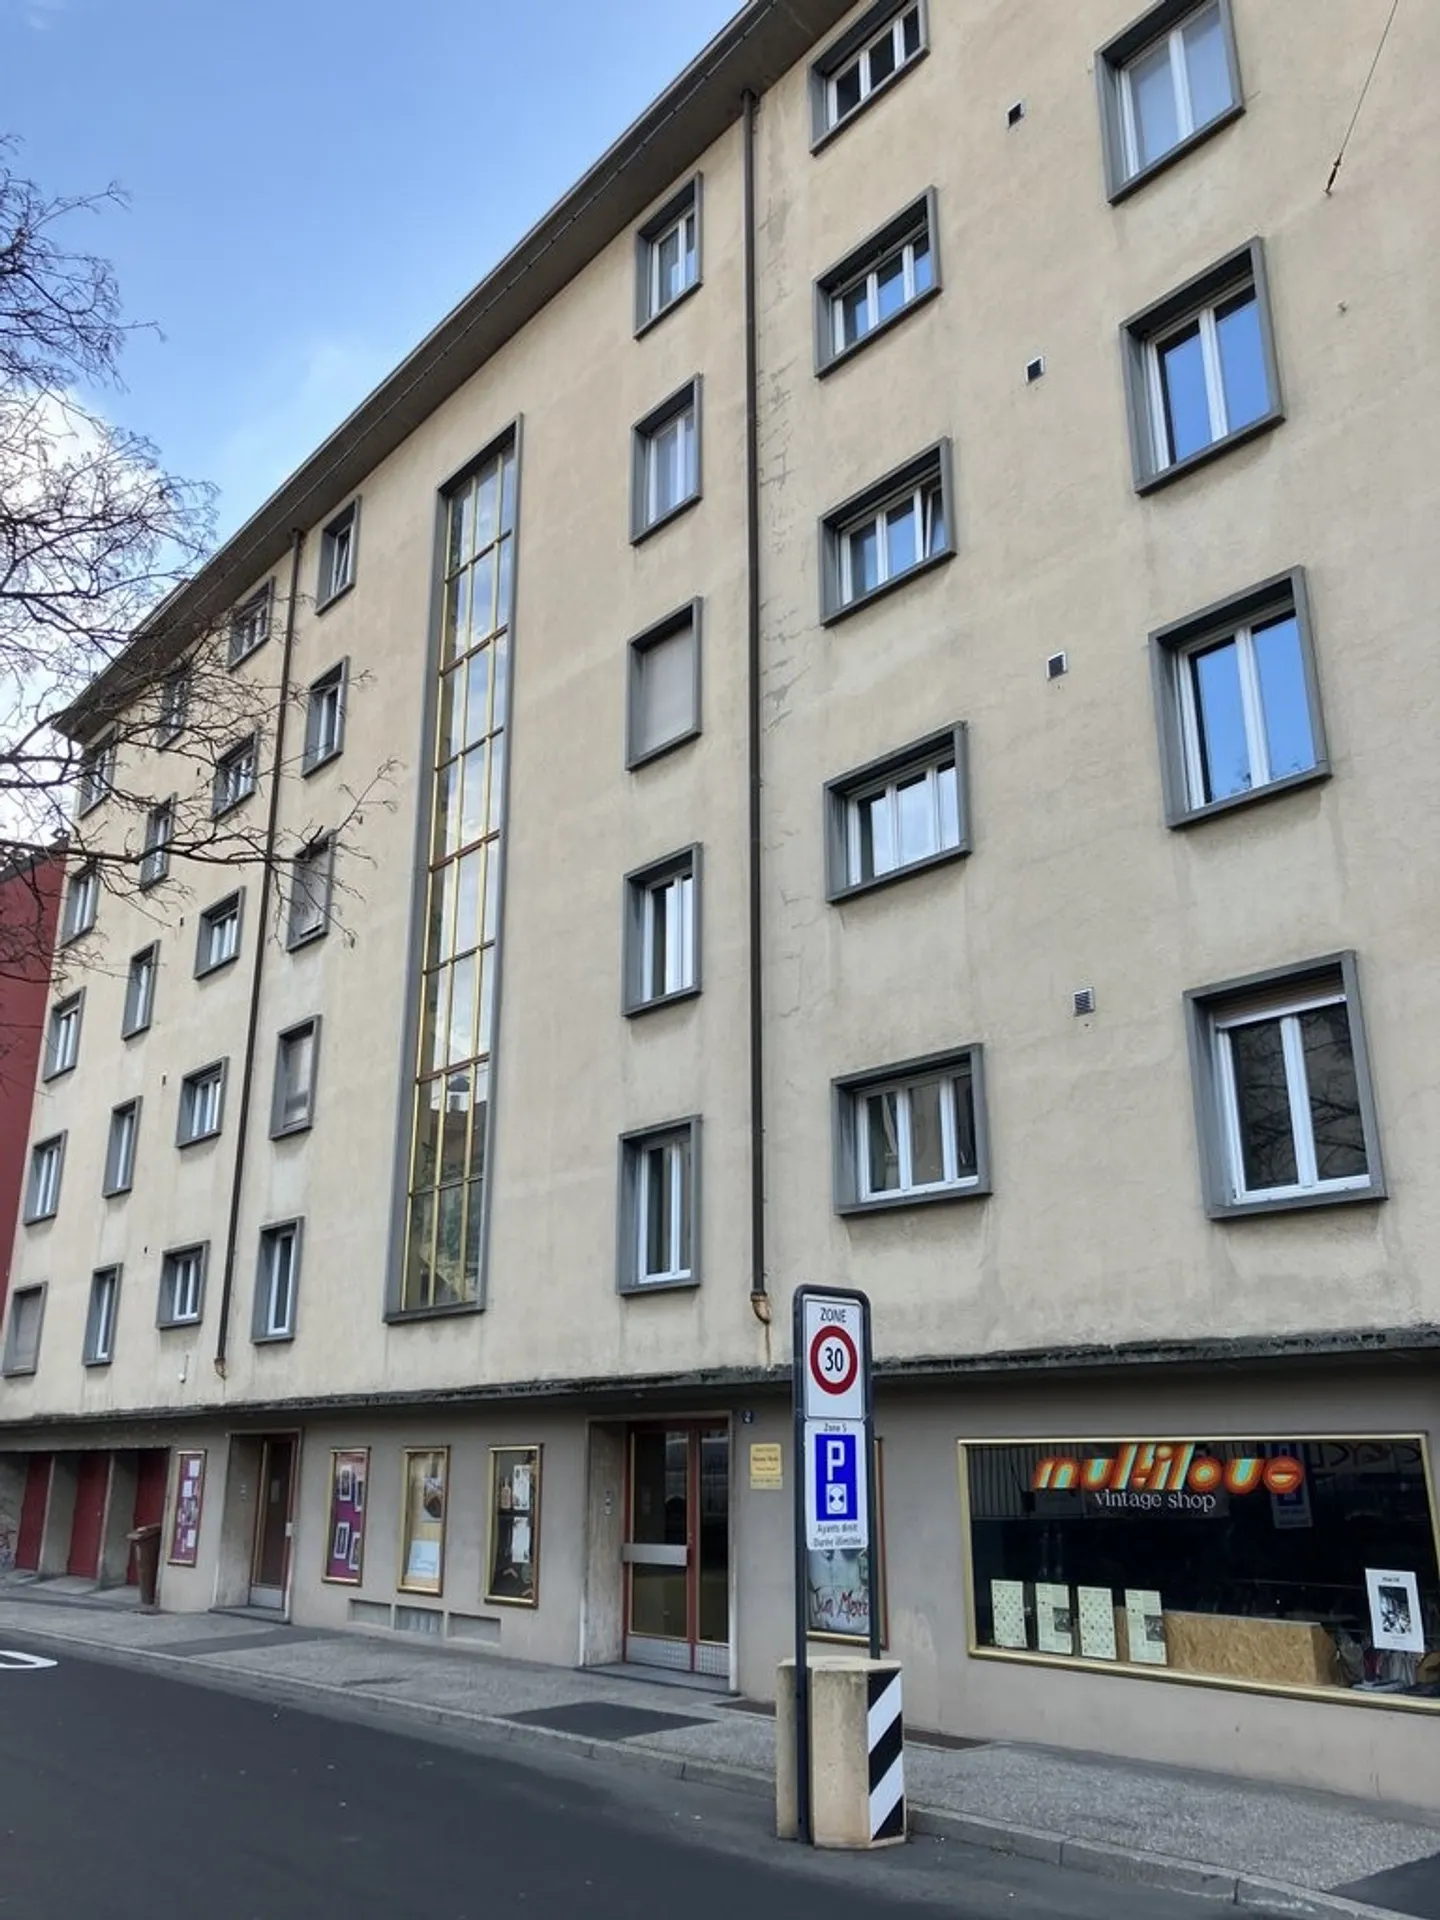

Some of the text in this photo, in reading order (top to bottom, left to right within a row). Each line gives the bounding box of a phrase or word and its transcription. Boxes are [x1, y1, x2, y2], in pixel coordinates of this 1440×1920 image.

[820, 1307, 847, 1323] ZONE
[825, 1346, 844, 1372] 30
[823, 1422, 841, 1432] Zone
[827, 1440, 845, 1481] P
[1095, 1488, 1217, 1513] vintage shop
